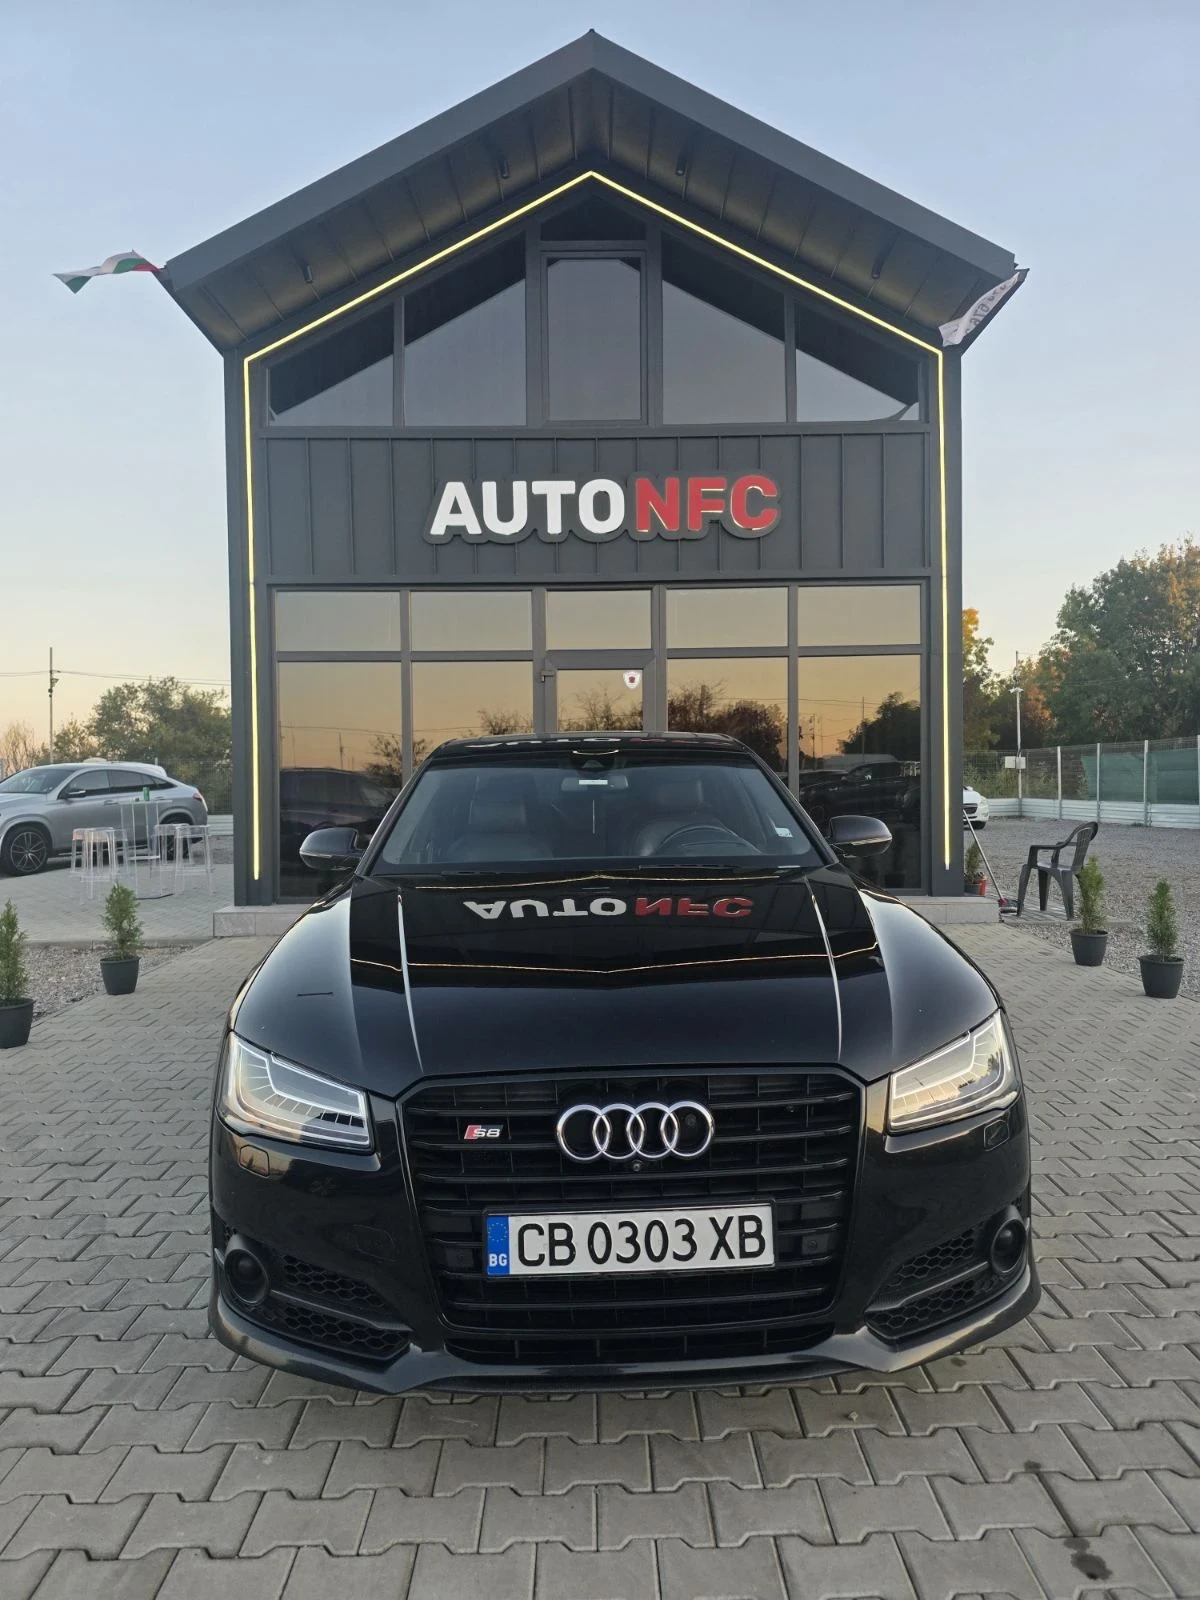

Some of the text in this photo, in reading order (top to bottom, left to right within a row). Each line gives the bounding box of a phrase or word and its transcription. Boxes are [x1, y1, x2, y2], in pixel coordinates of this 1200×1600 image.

[472, 1128, 501, 1138] S8
[517, 1214, 766, 1267] CB 0303 XB
[489, 1253, 507, 1267] BG
